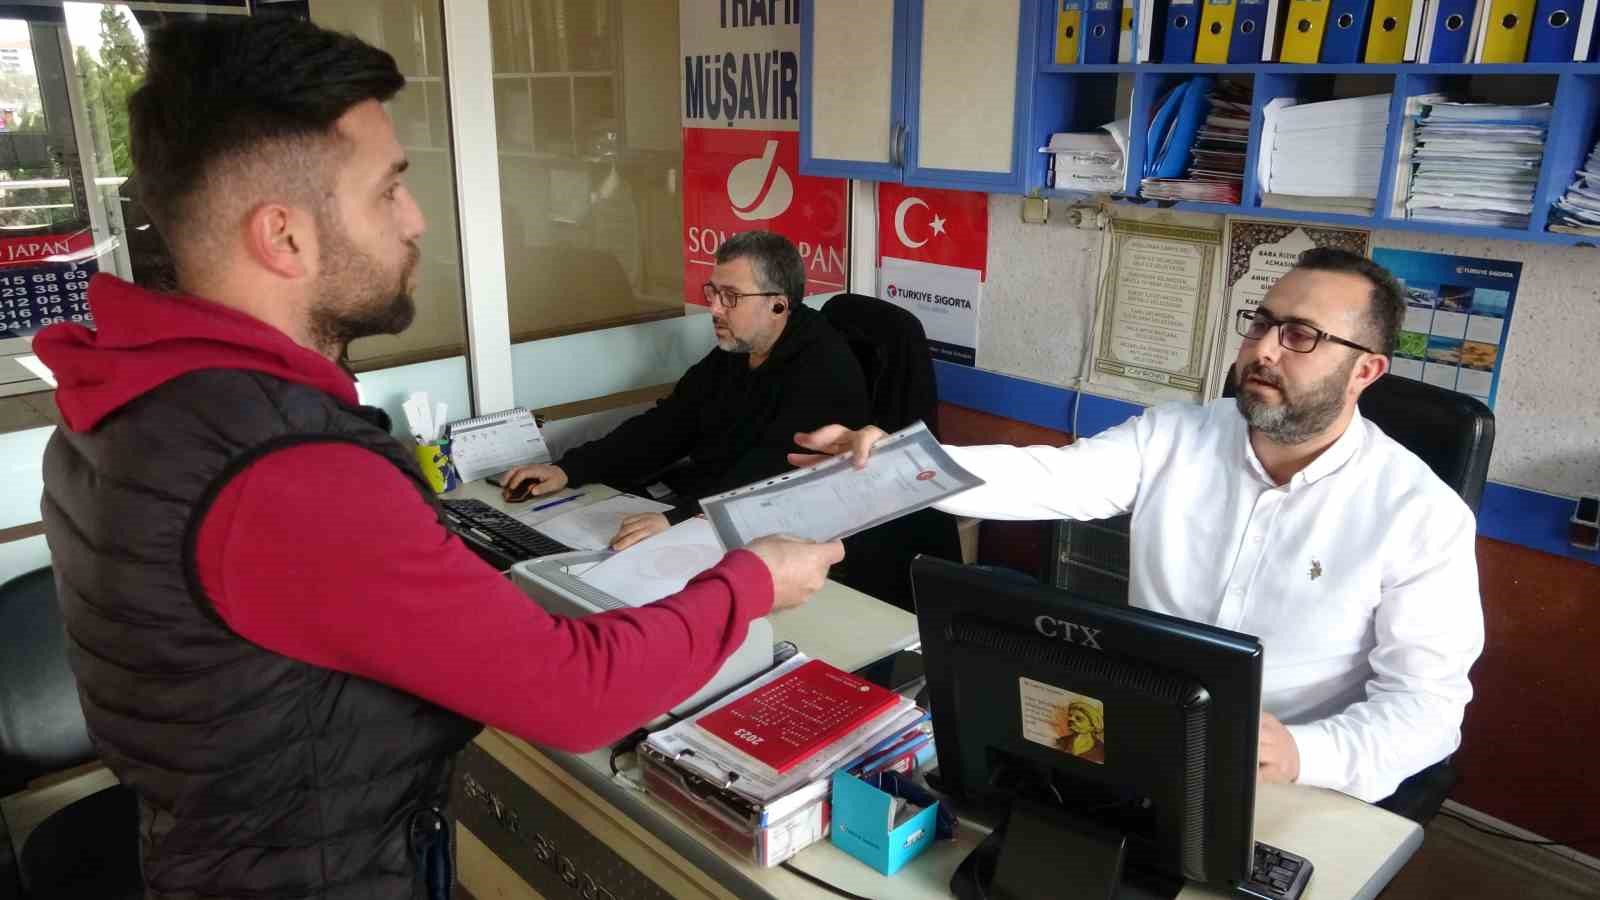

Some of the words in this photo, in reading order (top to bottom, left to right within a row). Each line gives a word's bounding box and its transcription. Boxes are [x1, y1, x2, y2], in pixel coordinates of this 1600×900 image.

[685, 50, 798, 127] MÜŞAVİR
[8, 239, 70, 260] JAPAN
[32, 272, 57, 283] 68
[64, 270, 88, 280] 63
[36, 294, 62, 305] 05
[40, 305, 64, 315] 14
[1034, 614, 1103, 650] CTX
[734, 728, 765, 746] 2023
